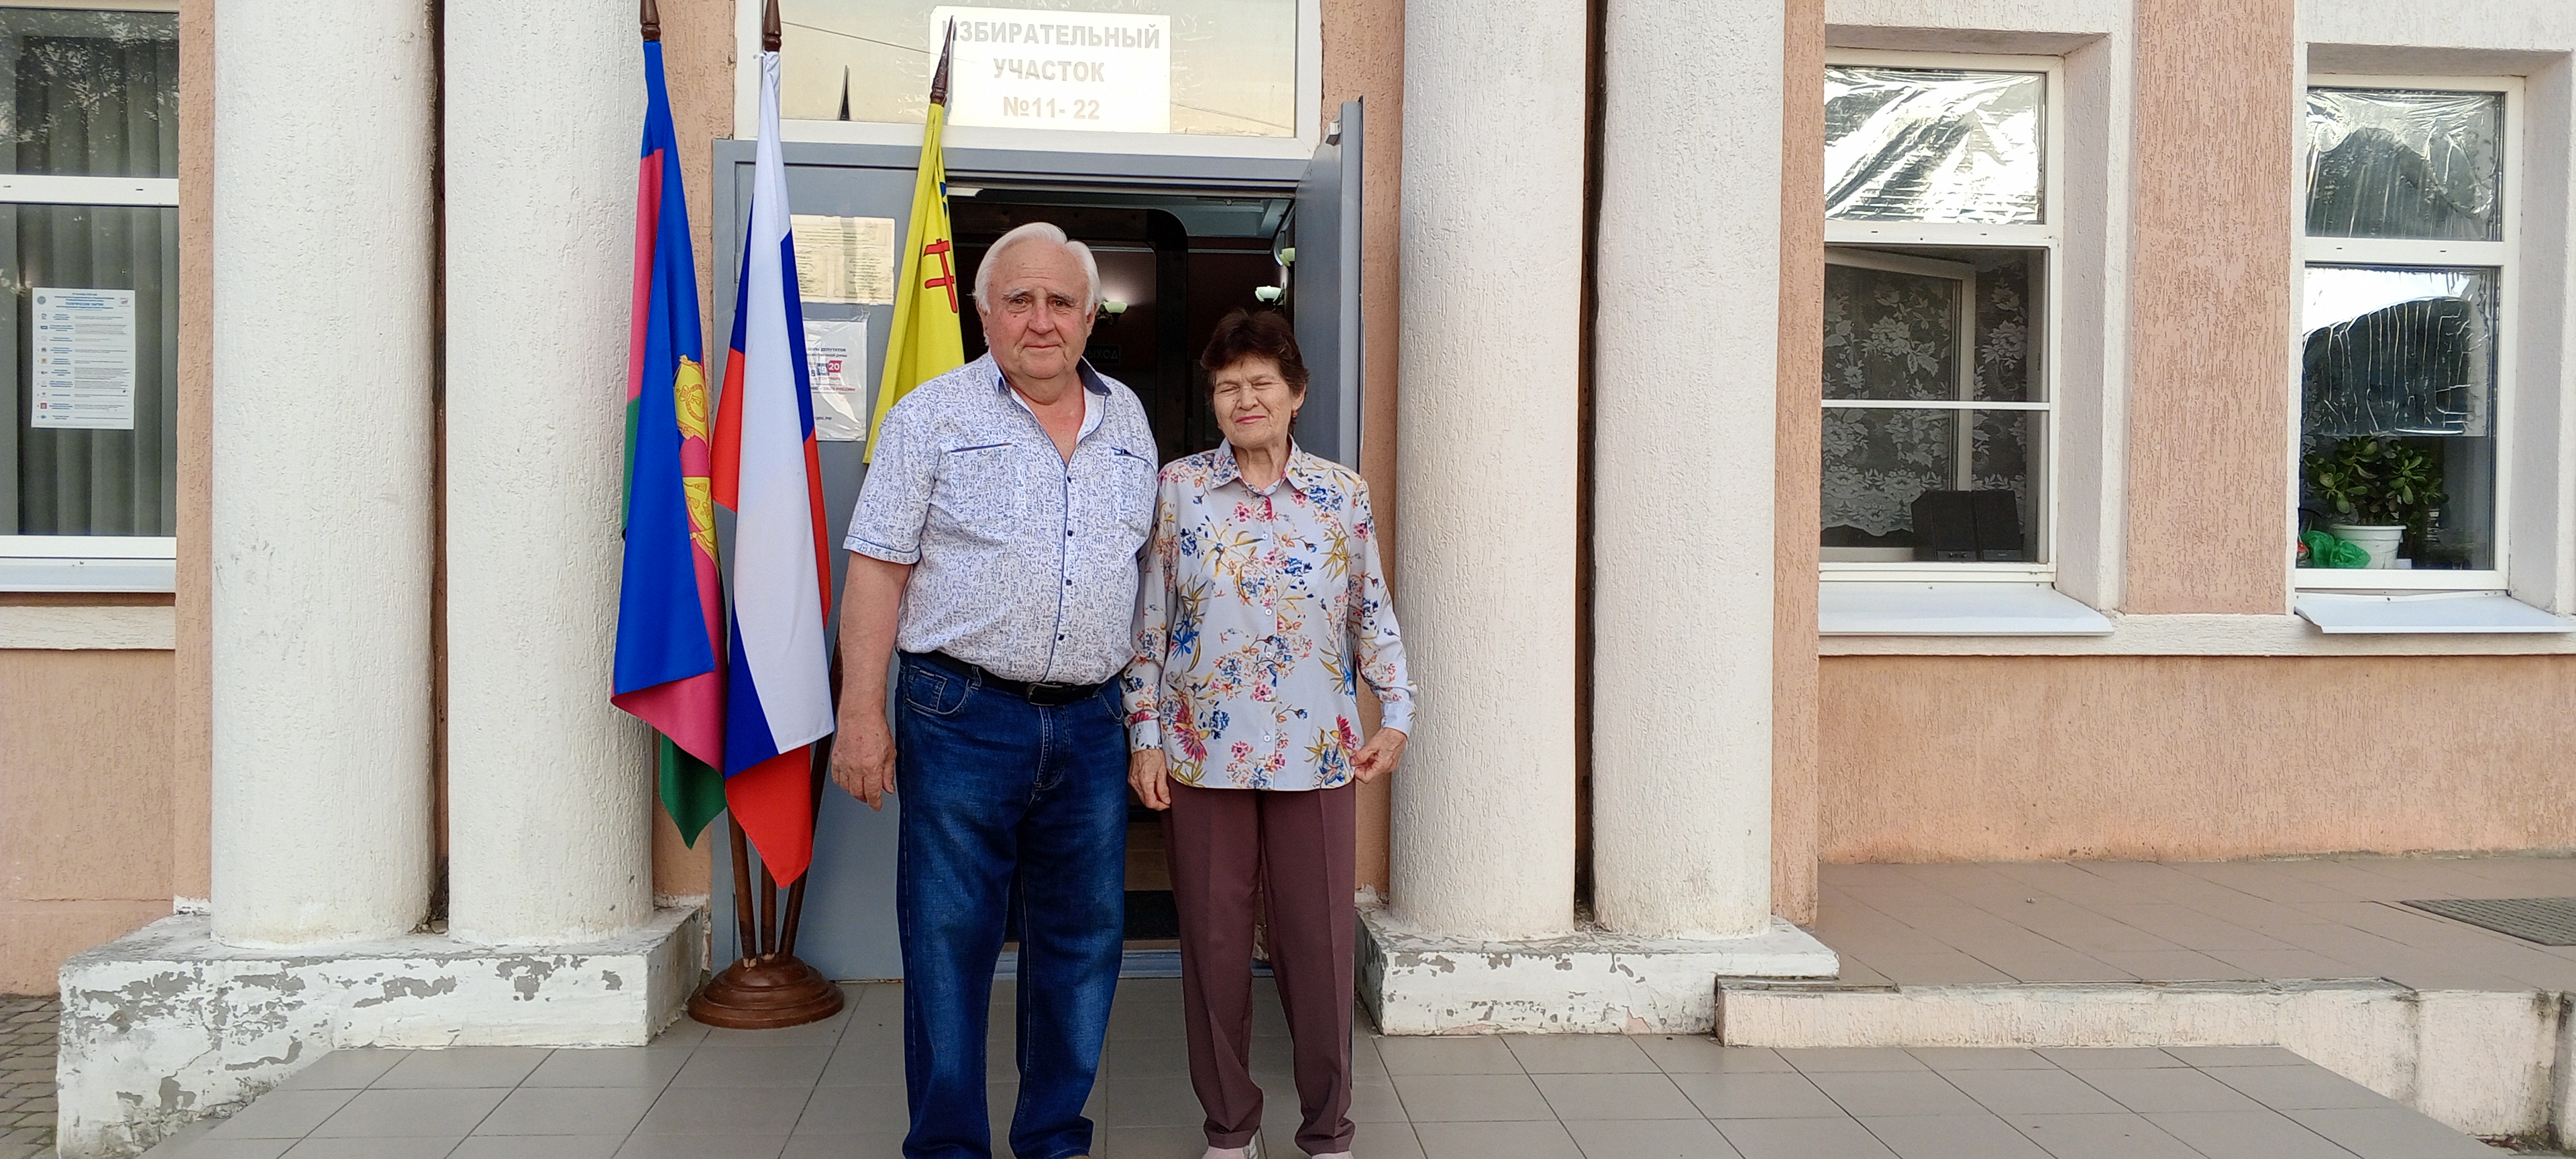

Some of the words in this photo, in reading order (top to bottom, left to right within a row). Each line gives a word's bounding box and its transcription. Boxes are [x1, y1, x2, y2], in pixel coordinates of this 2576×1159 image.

[943, 21, 1159, 49] ИЗБИРАТЕЛЬНЫЙ
[994, 58, 1105, 82] УЧАСТОК
[1004, 97, 1065, 118] №11-
[1073, 99, 1099, 119] 22
[828, 363, 840, 371] 20
